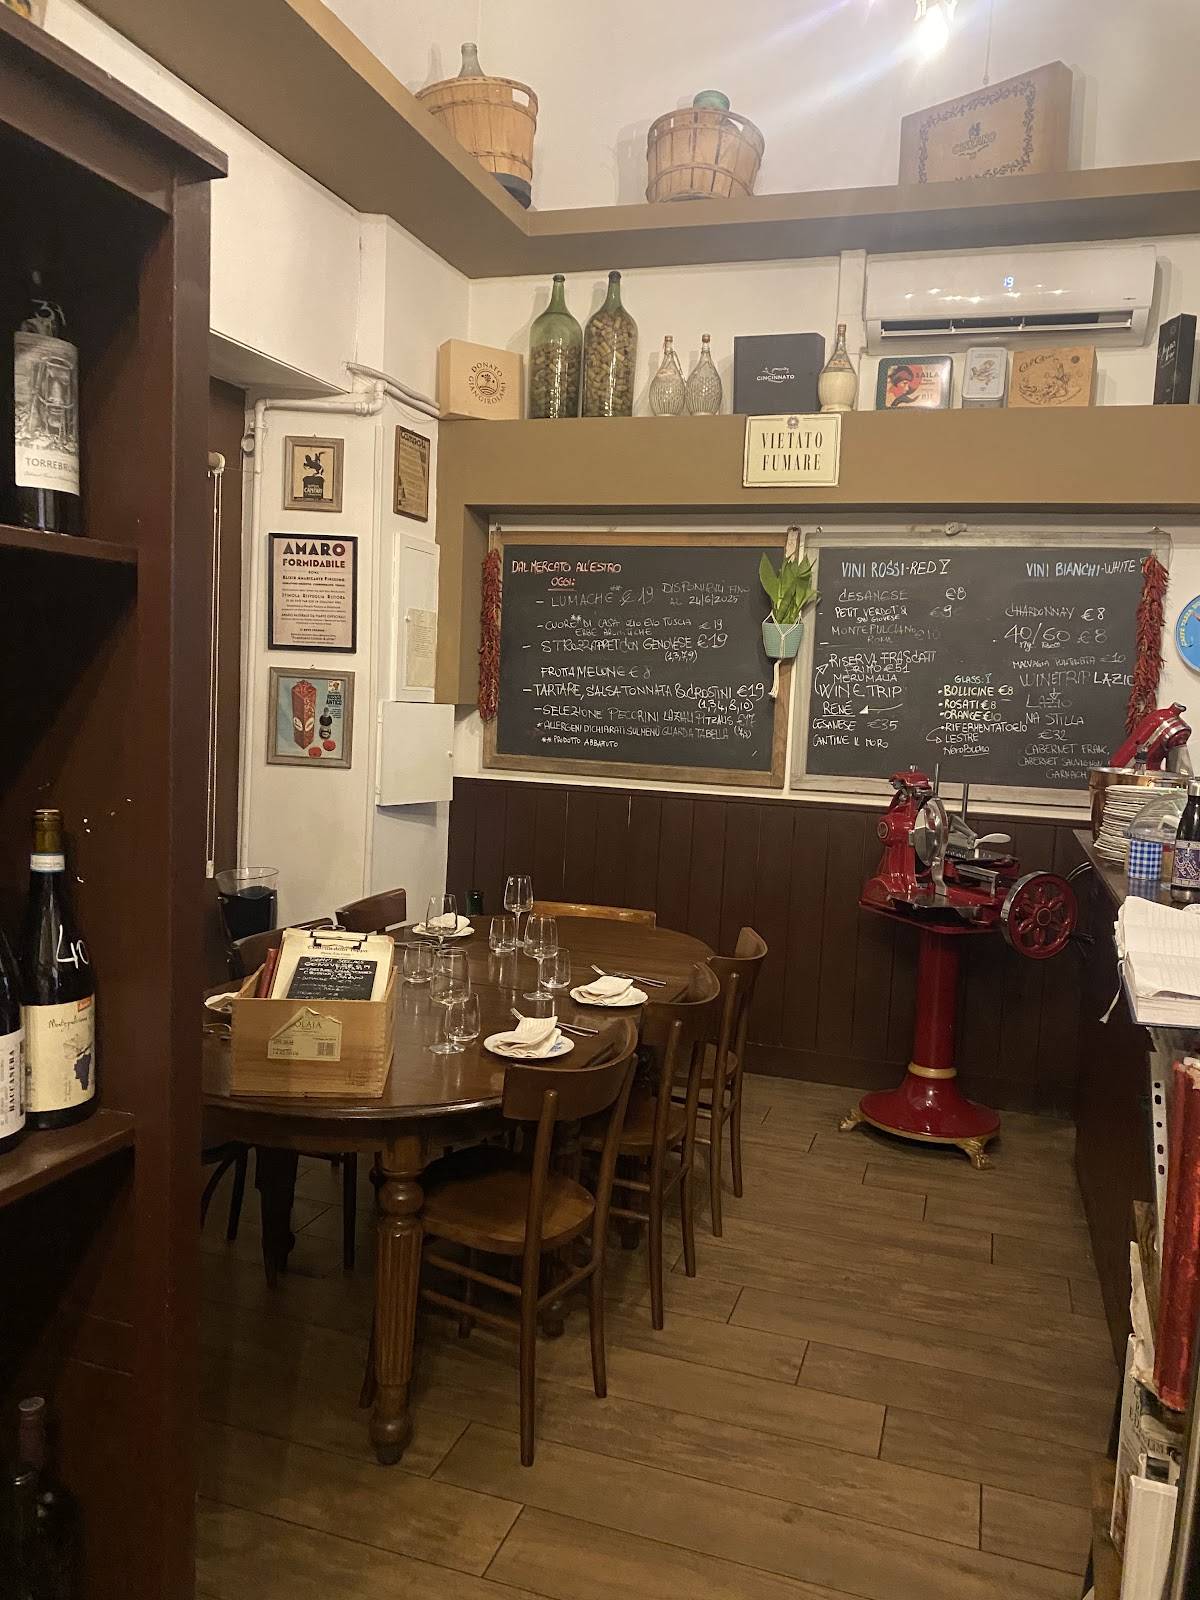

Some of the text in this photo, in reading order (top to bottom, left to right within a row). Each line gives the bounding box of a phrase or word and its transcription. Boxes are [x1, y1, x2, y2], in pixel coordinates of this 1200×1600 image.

[1003, 276, 1014, 288] 19
[471, 361, 503, 377] DONATO
[756, 374, 795, 382] CINCINNATO
[761, 432, 823, 449] VIETATO
[762, 454, 821, 471] FUMARE
[283, 541, 346, 557] AMARO
[282, 558, 346, 569] FORMIDABILE
[512, 560, 528, 573] DAL
[530, 560, 572, 574] MERCATO
[841, 561, 866, 578] VINI
[1026, 562, 1049, 577] VINI
[551, 576, 576, 587] OGGI:
[638, 586, 654, 605] 19
[834, 606, 859, 619] PETIT
[585, 684, 622, 698] SALSA
[621, 683, 673, 698] TONNATA
[943, 684, 995, 697] BOLLICINE
[944, 699, 979, 709] ROSATI
[1045, 712, 1085, 727] STILLA
[56, 924, 90, 970] 40
